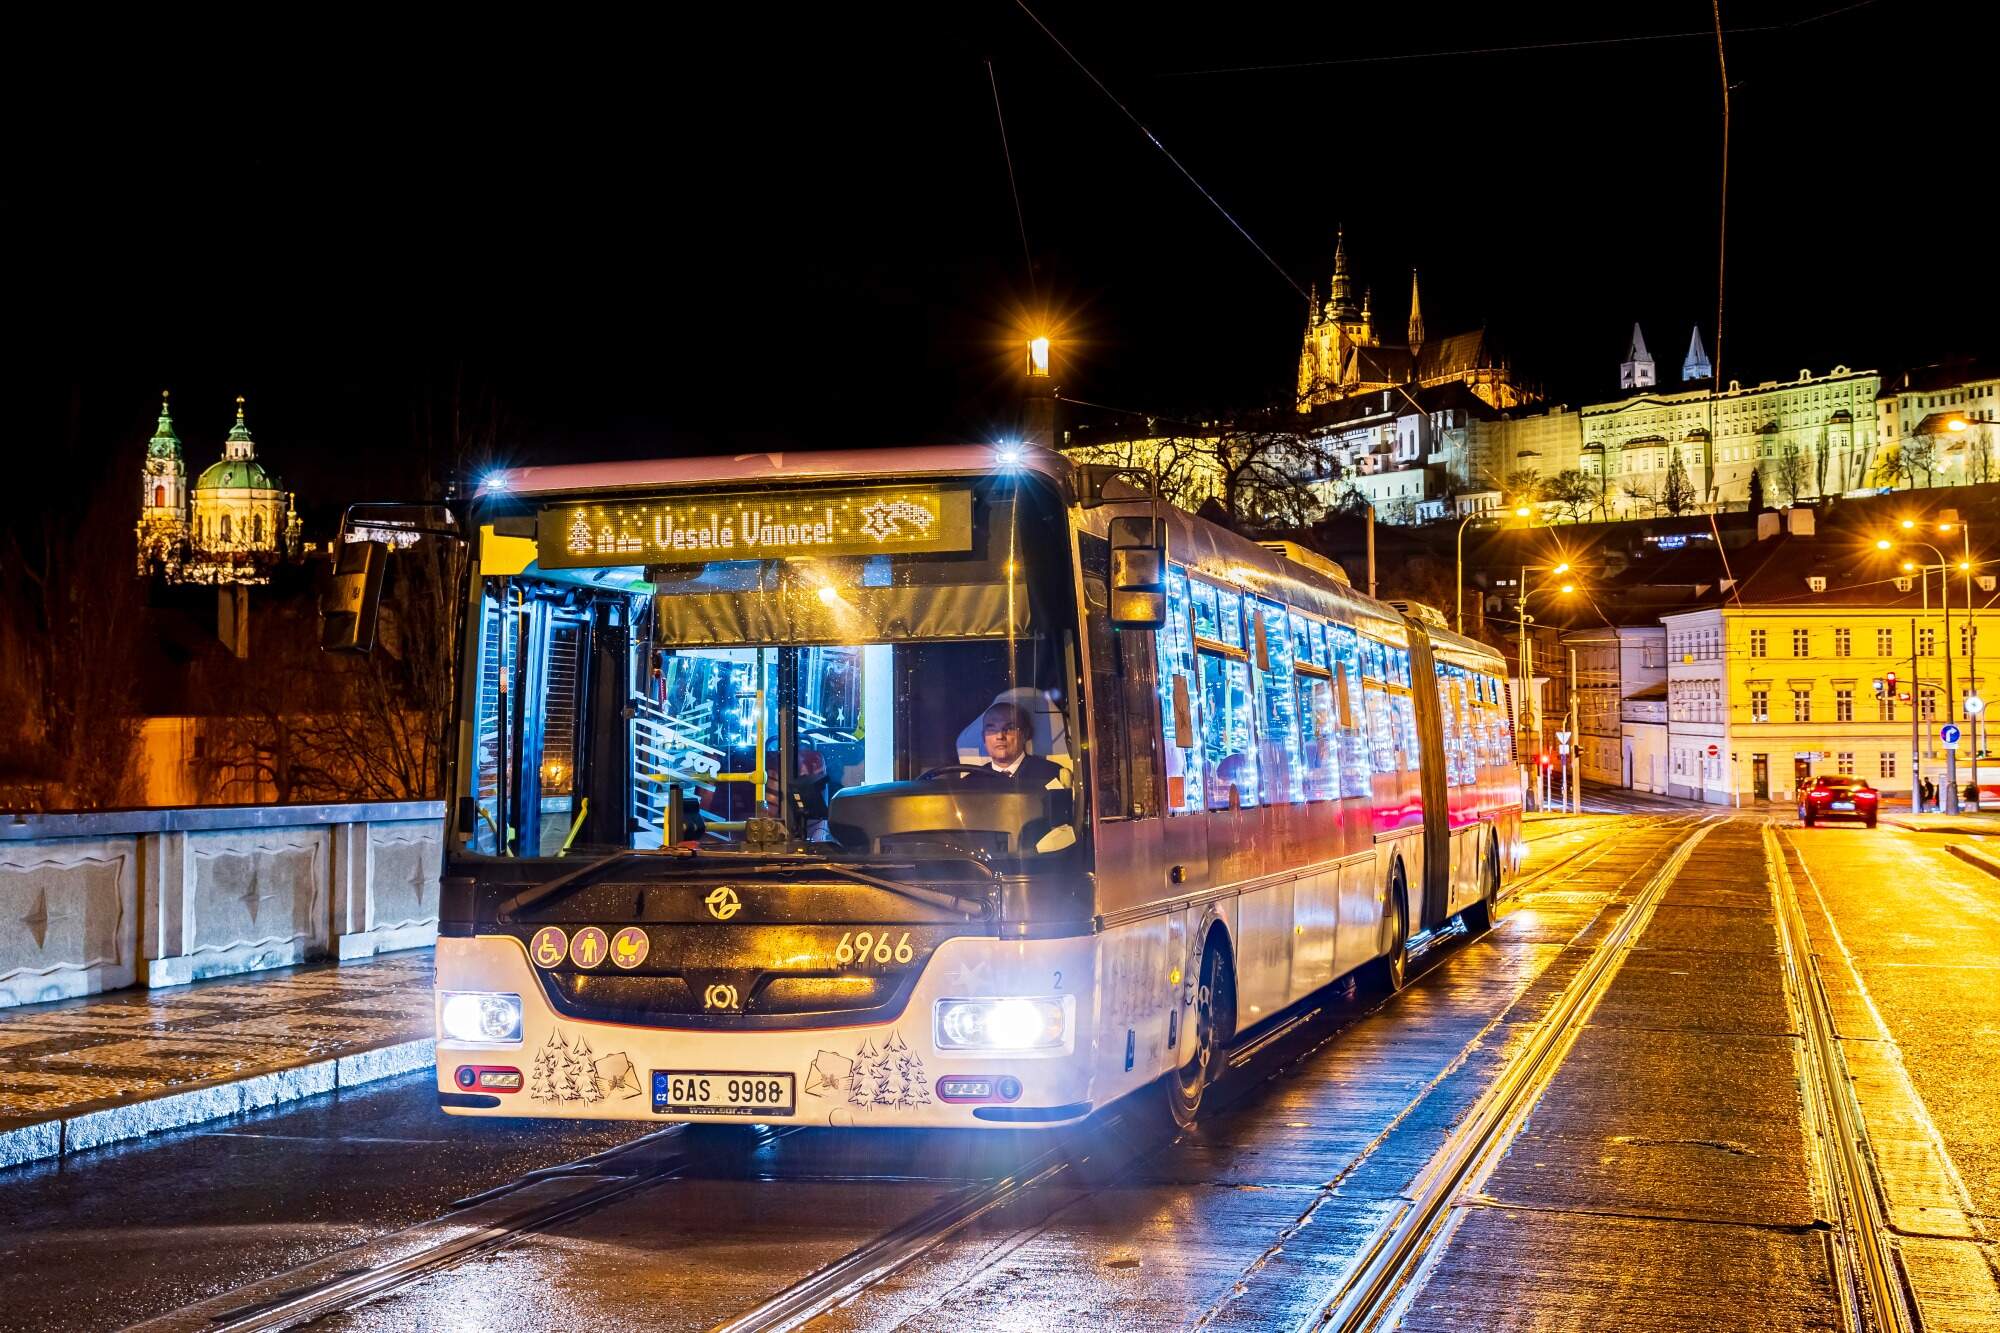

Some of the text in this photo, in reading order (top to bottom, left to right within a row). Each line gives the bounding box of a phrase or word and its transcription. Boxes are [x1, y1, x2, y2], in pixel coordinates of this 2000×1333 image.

[655, 507, 833, 550] Veselé Vánoce!
[835, 931, 914, 964] 6966
[1053, 970, 1063, 990] 2
[656, 1078, 781, 1103] CZ 6AS 9988
